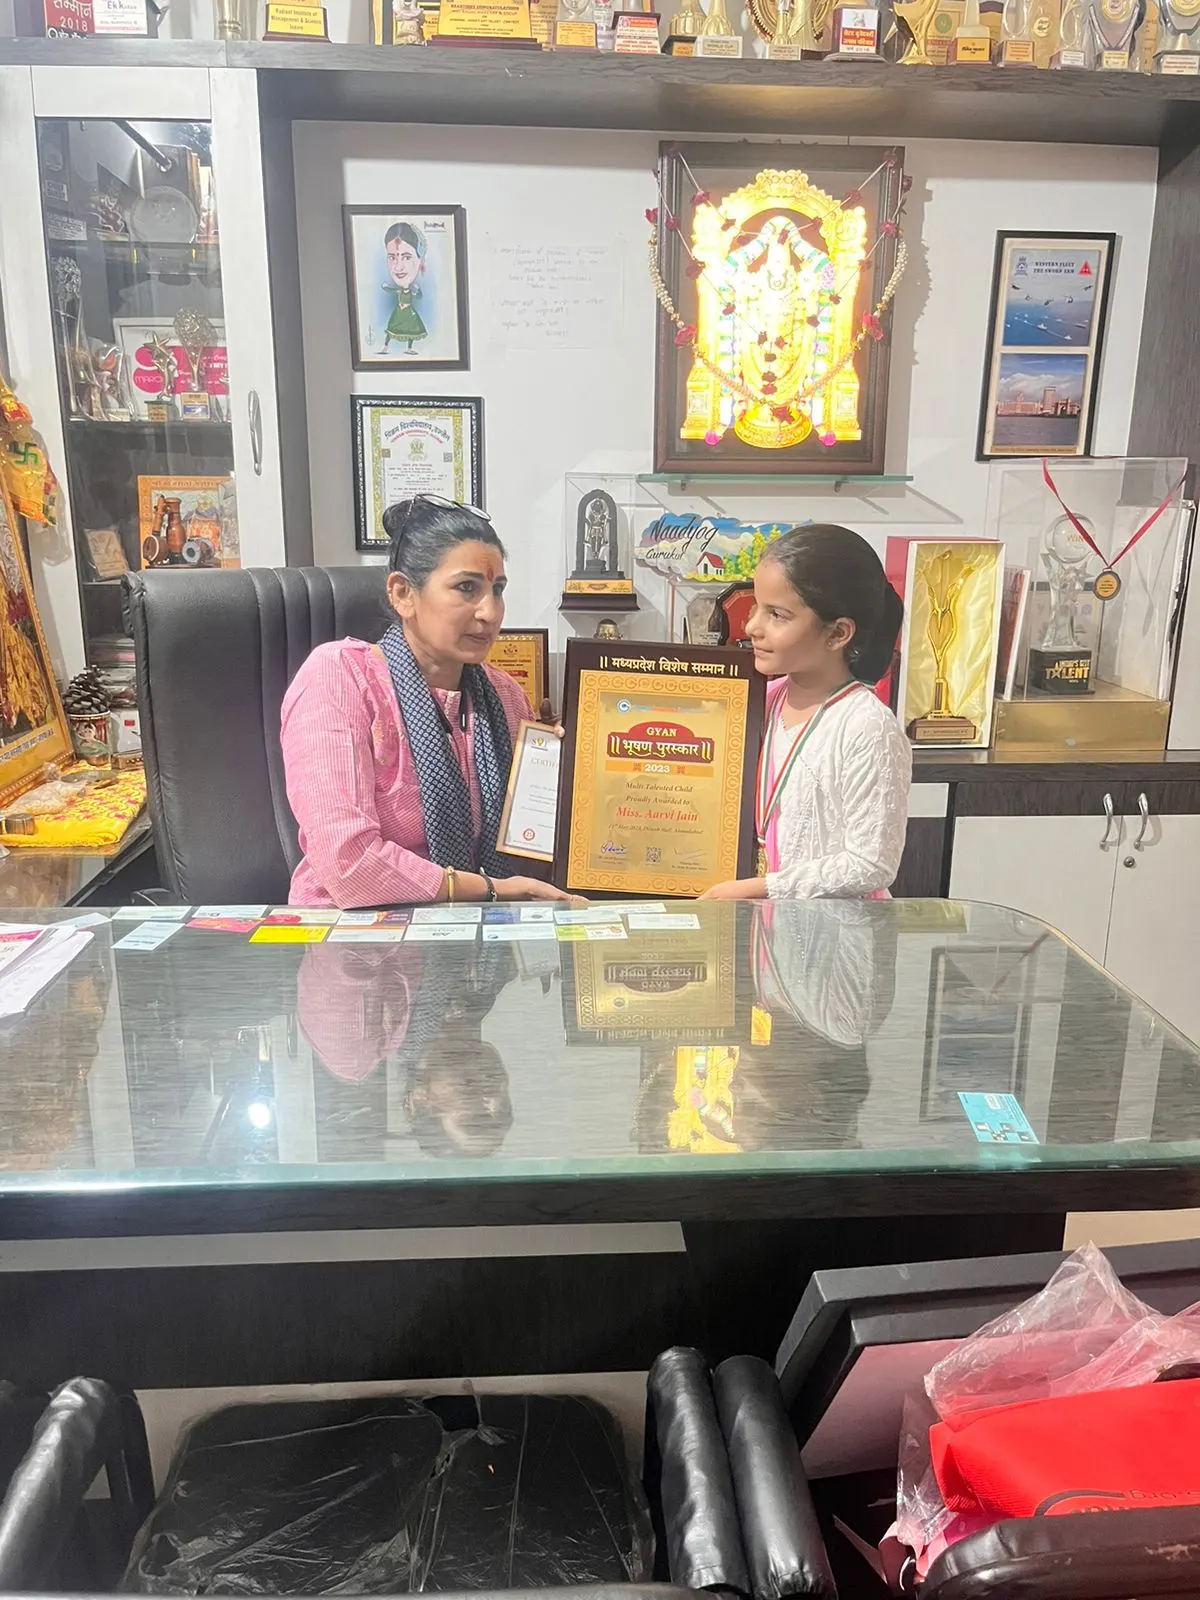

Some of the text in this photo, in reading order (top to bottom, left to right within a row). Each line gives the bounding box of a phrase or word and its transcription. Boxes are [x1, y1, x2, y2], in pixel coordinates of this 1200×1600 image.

[60, 16, 88, 32] 2018
[650, 516, 719, 552] Naadyog
[645, 547, 686, 560] Gurukul
[611, 655, 656, 671] मध्यप्रदेश
[659, 657, 689, 672] विशेष
[691, 662, 725, 675] सम्मान
[646, 727, 678, 737] GYAN
[622, 739, 653, 757] भूषण
[653, 741, 700, 758] पुरस्कार
[644, 763, 670, 773] 2023
[625, 782, 694, 793] Multi Talented Child
[625, 795, 651, 804] Proudly
[652, 797, 682, 805] Awarded
[616, 806, 699, 823] Miss. Aarvi Jain
